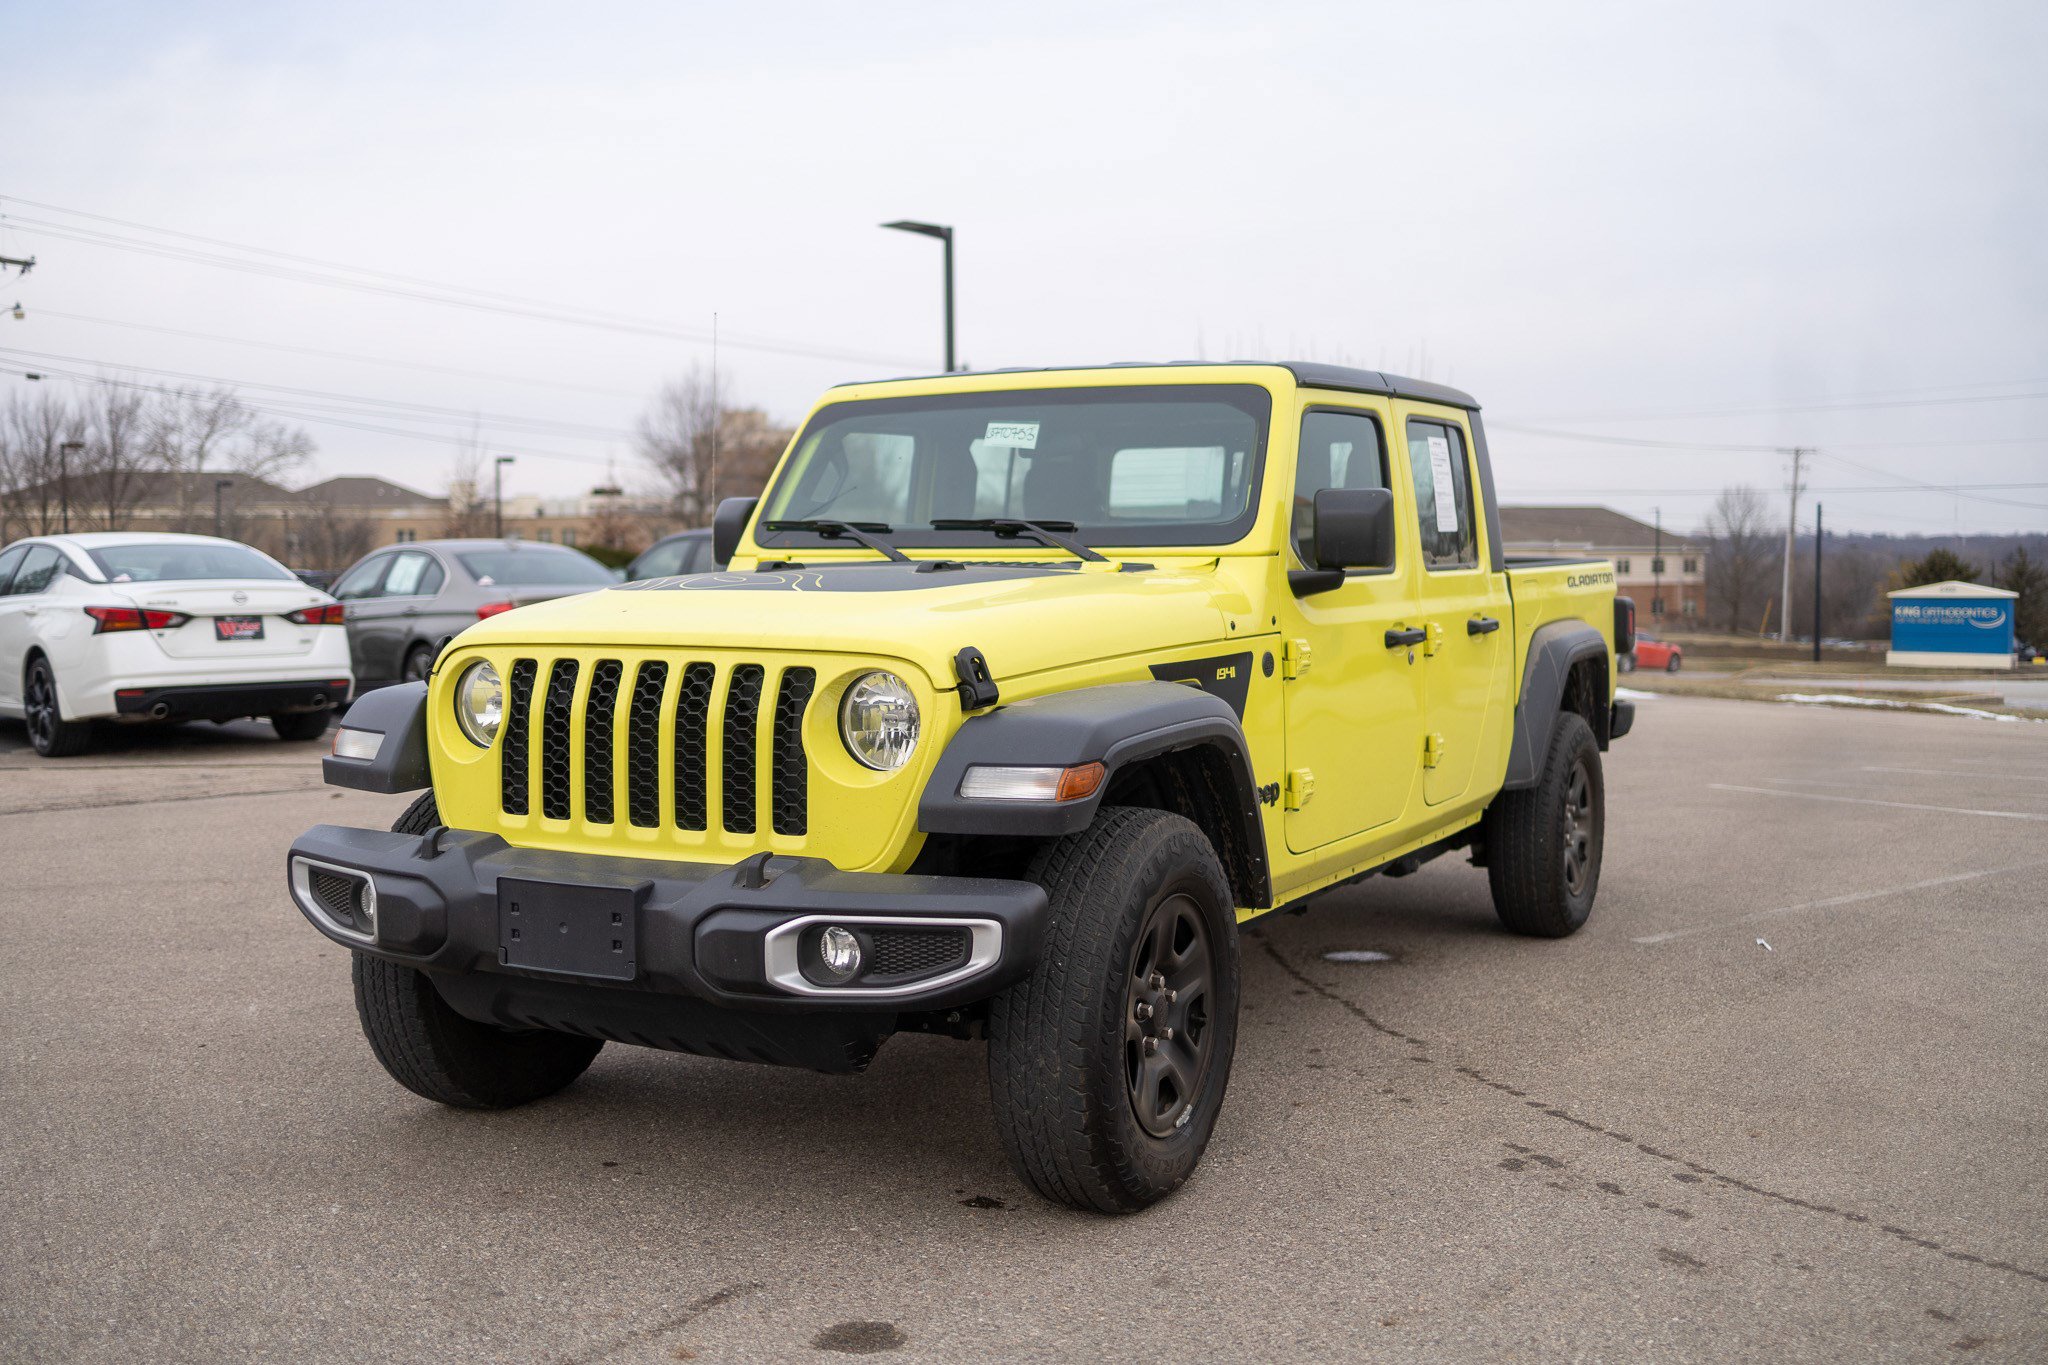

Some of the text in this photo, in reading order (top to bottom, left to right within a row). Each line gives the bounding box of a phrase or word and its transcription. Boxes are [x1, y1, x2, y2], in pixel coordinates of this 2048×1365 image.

[1567, 572, 1614, 588] GLADIATOR
[1895, 605, 1998, 618] KING ORTHODONTICS
[1216, 666, 1236, 680] 1941
[1257, 782, 1280, 807] eep
